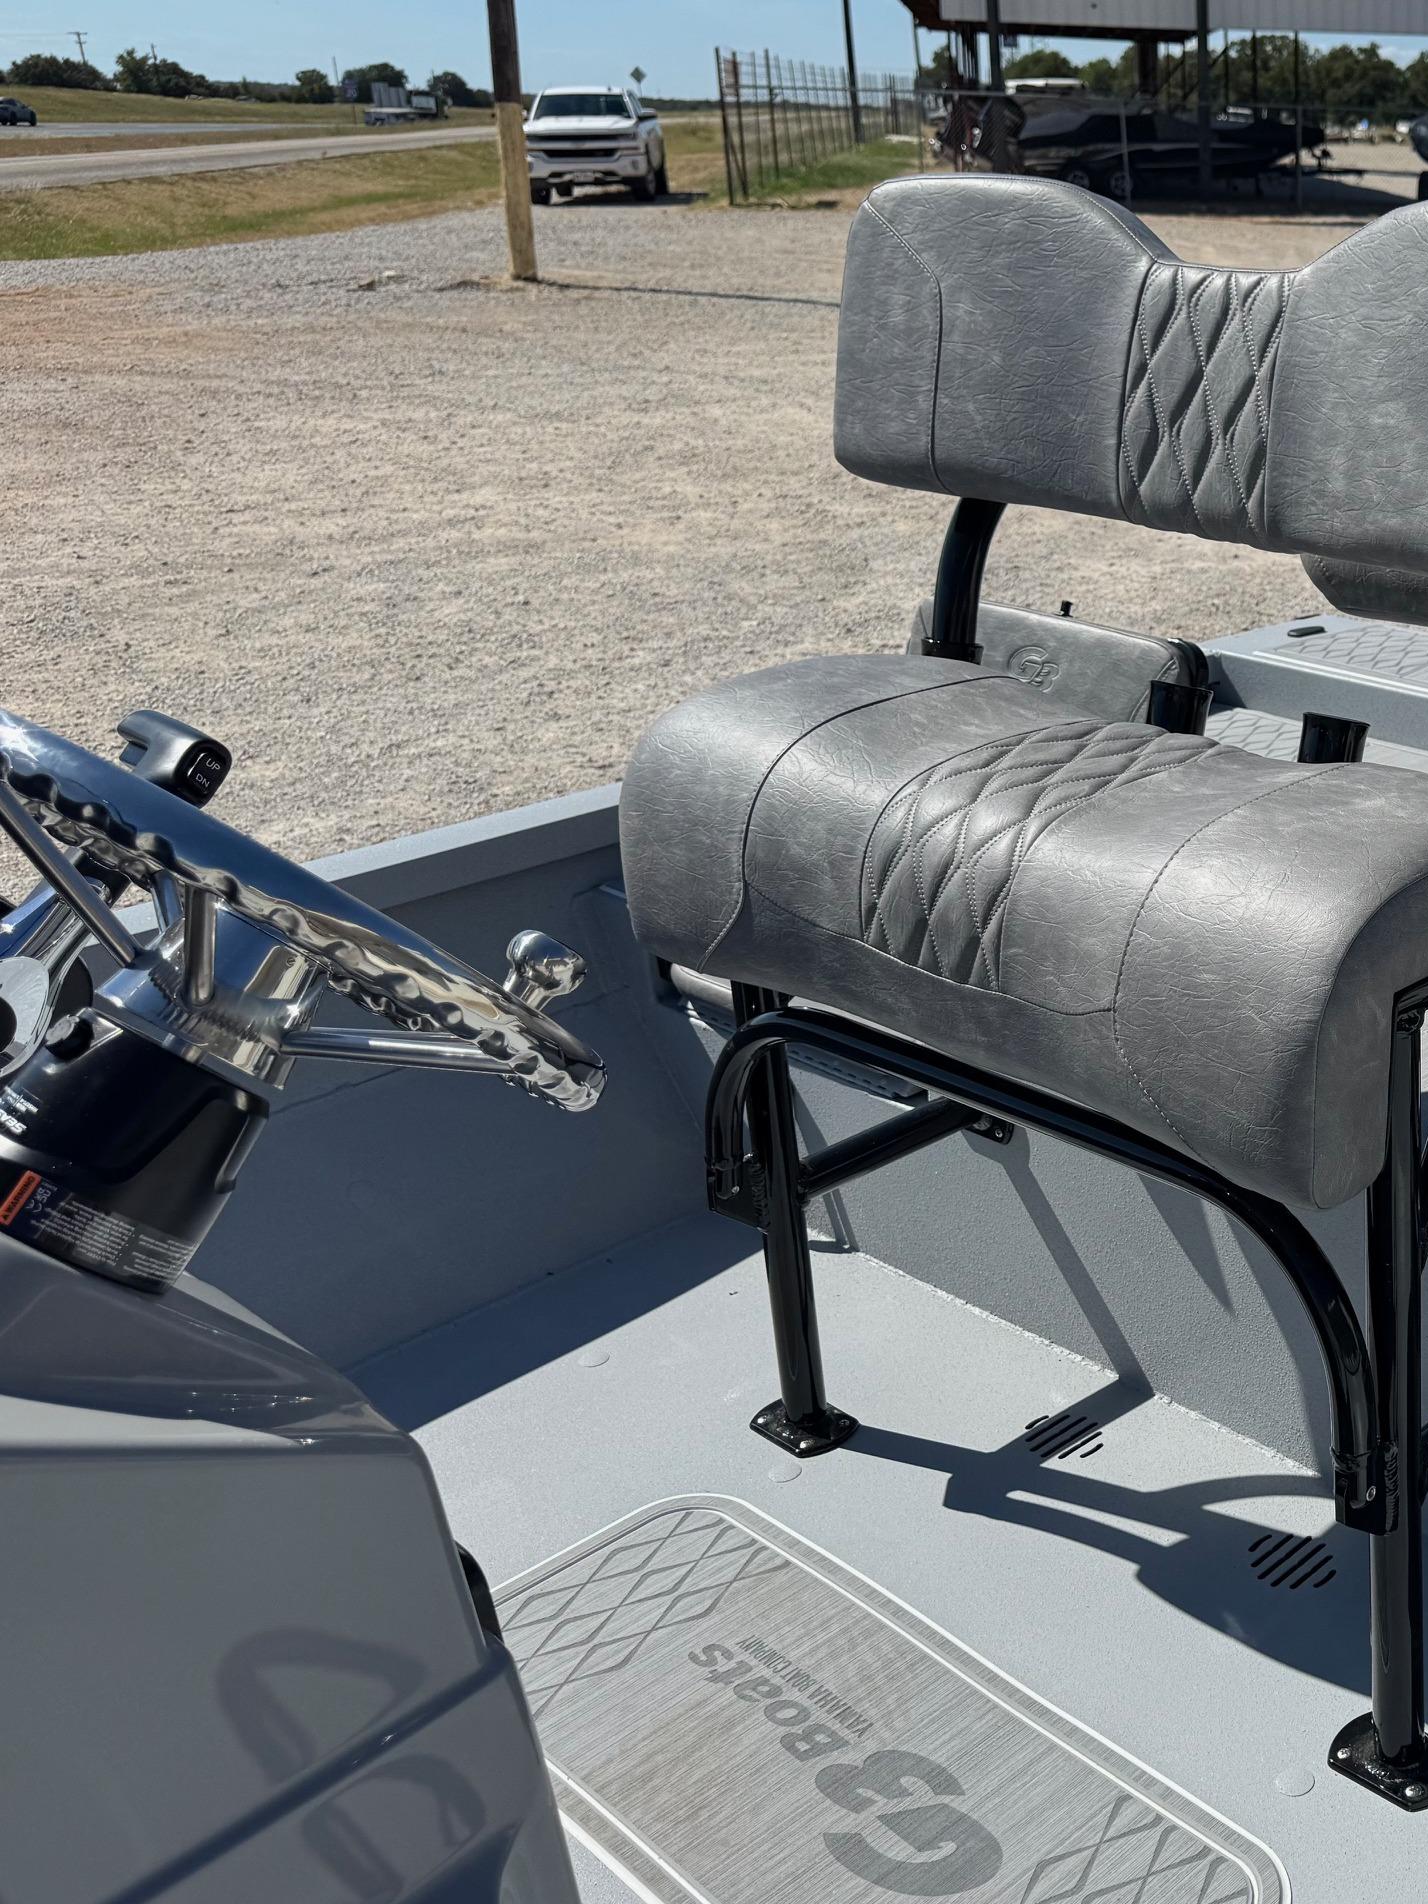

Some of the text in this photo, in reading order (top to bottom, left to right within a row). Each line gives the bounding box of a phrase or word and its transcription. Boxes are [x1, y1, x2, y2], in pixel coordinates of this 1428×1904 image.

[195, 773, 210, 788] DN
[205, 758, 221, 770] UP
[736, 1634, 875, 1739] YAMAHA BOAT COMPANY
[688, 1643, 1004, 1897] G3 Boats
